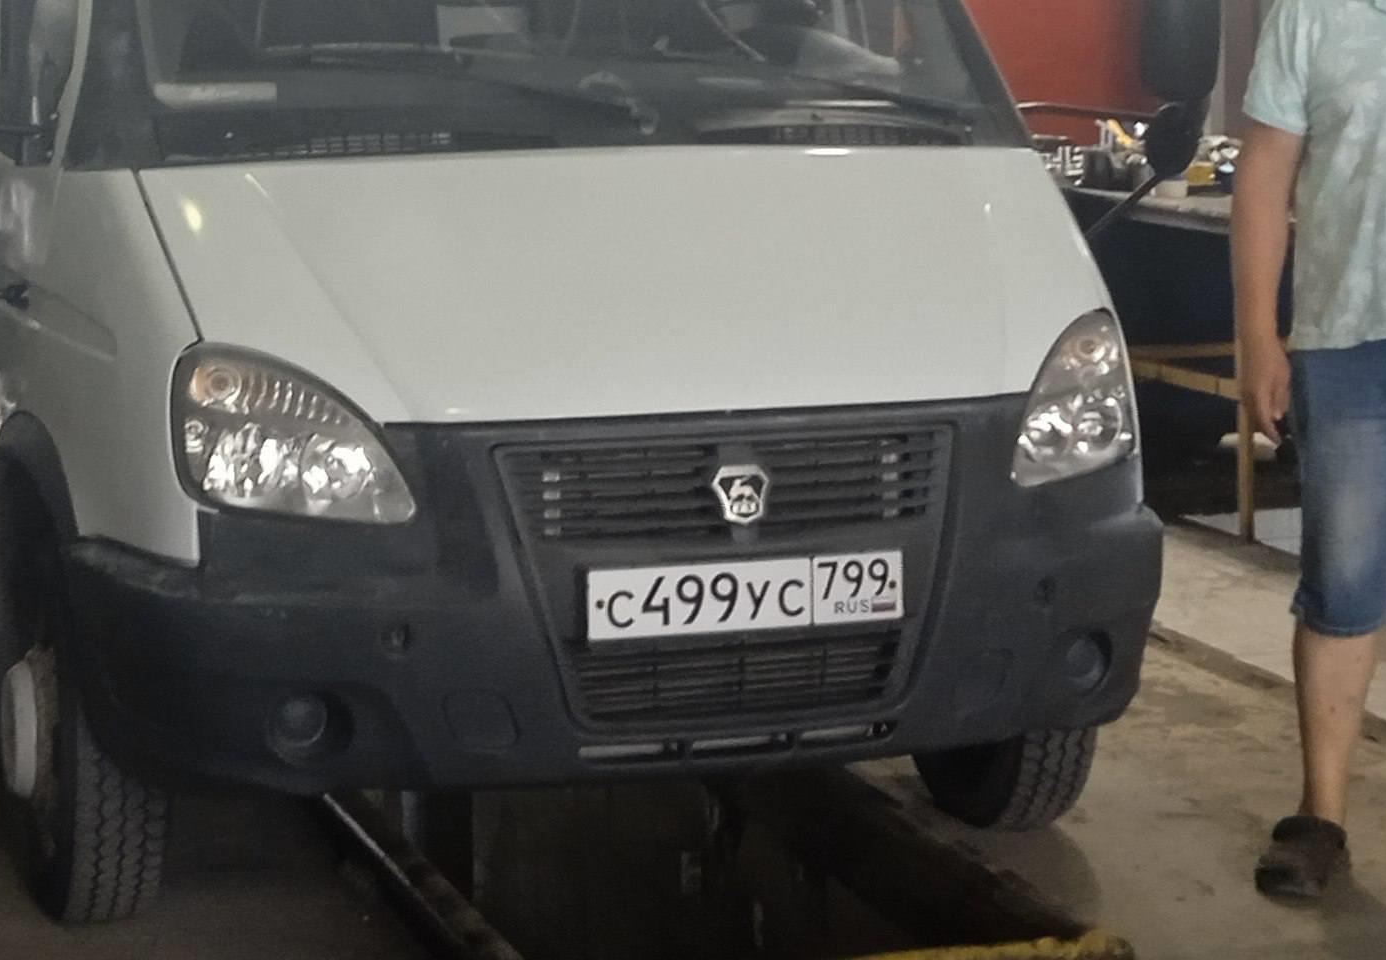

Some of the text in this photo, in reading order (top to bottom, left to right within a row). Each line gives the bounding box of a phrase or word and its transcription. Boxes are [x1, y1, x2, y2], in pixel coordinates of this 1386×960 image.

[607, 572, 805, 628] С499УС
[817, 558, 890, 600] 799
[834, 598, 870, 614] RUS
